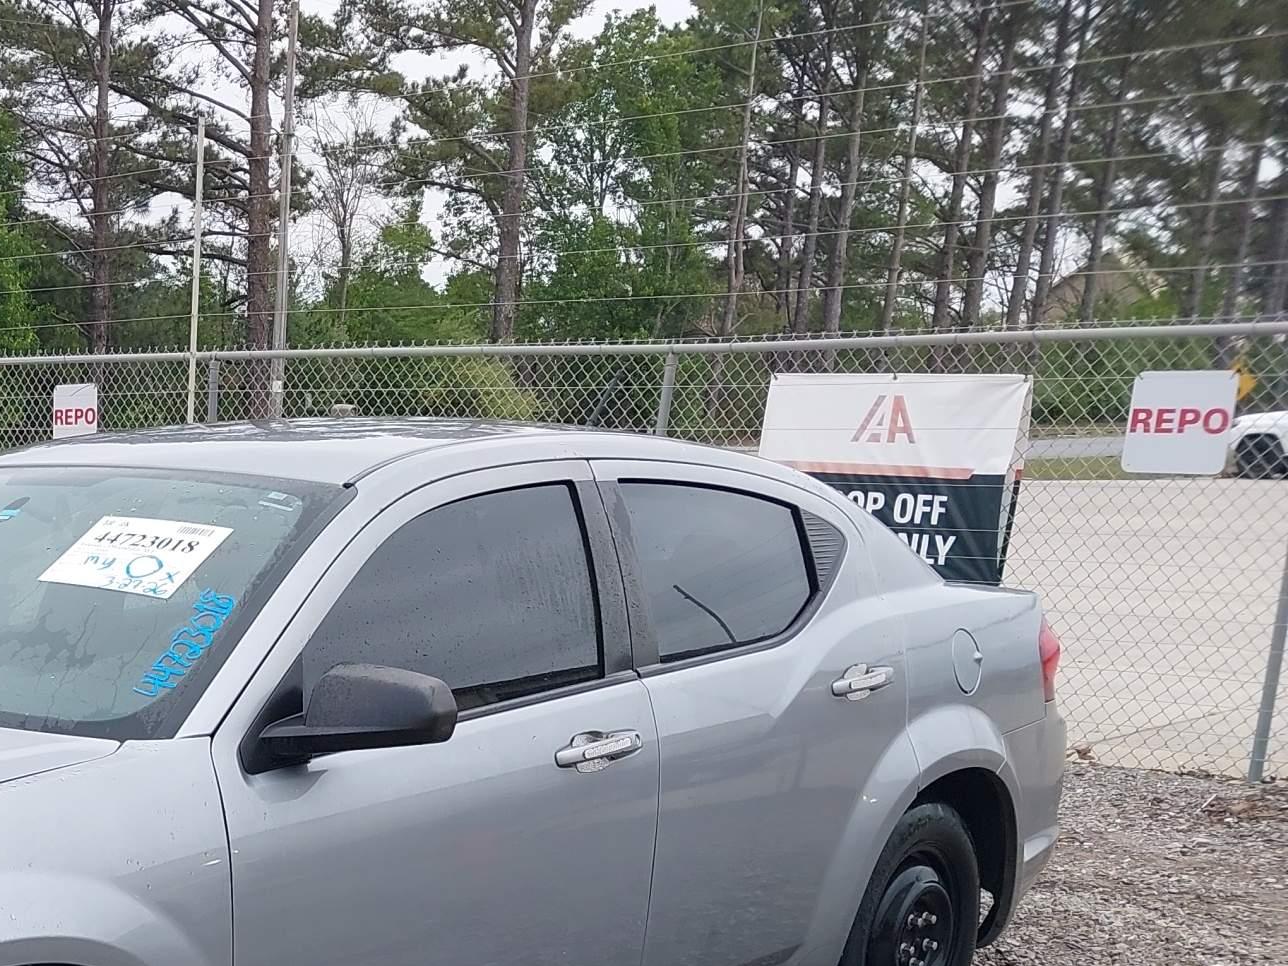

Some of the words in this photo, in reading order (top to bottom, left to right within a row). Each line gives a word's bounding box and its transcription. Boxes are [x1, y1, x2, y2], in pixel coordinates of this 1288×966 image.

[55, 408, 96, 425] REPO
[1130, 408, 1229, 434] REPO
[839, 490, 886, 514] OP
[893, 493, 948, 525] OFF
[94, 531, 200, 553] 44723018
[898, 533, 956, 565] NLY
[133, 587, 236, 697] 44723018
